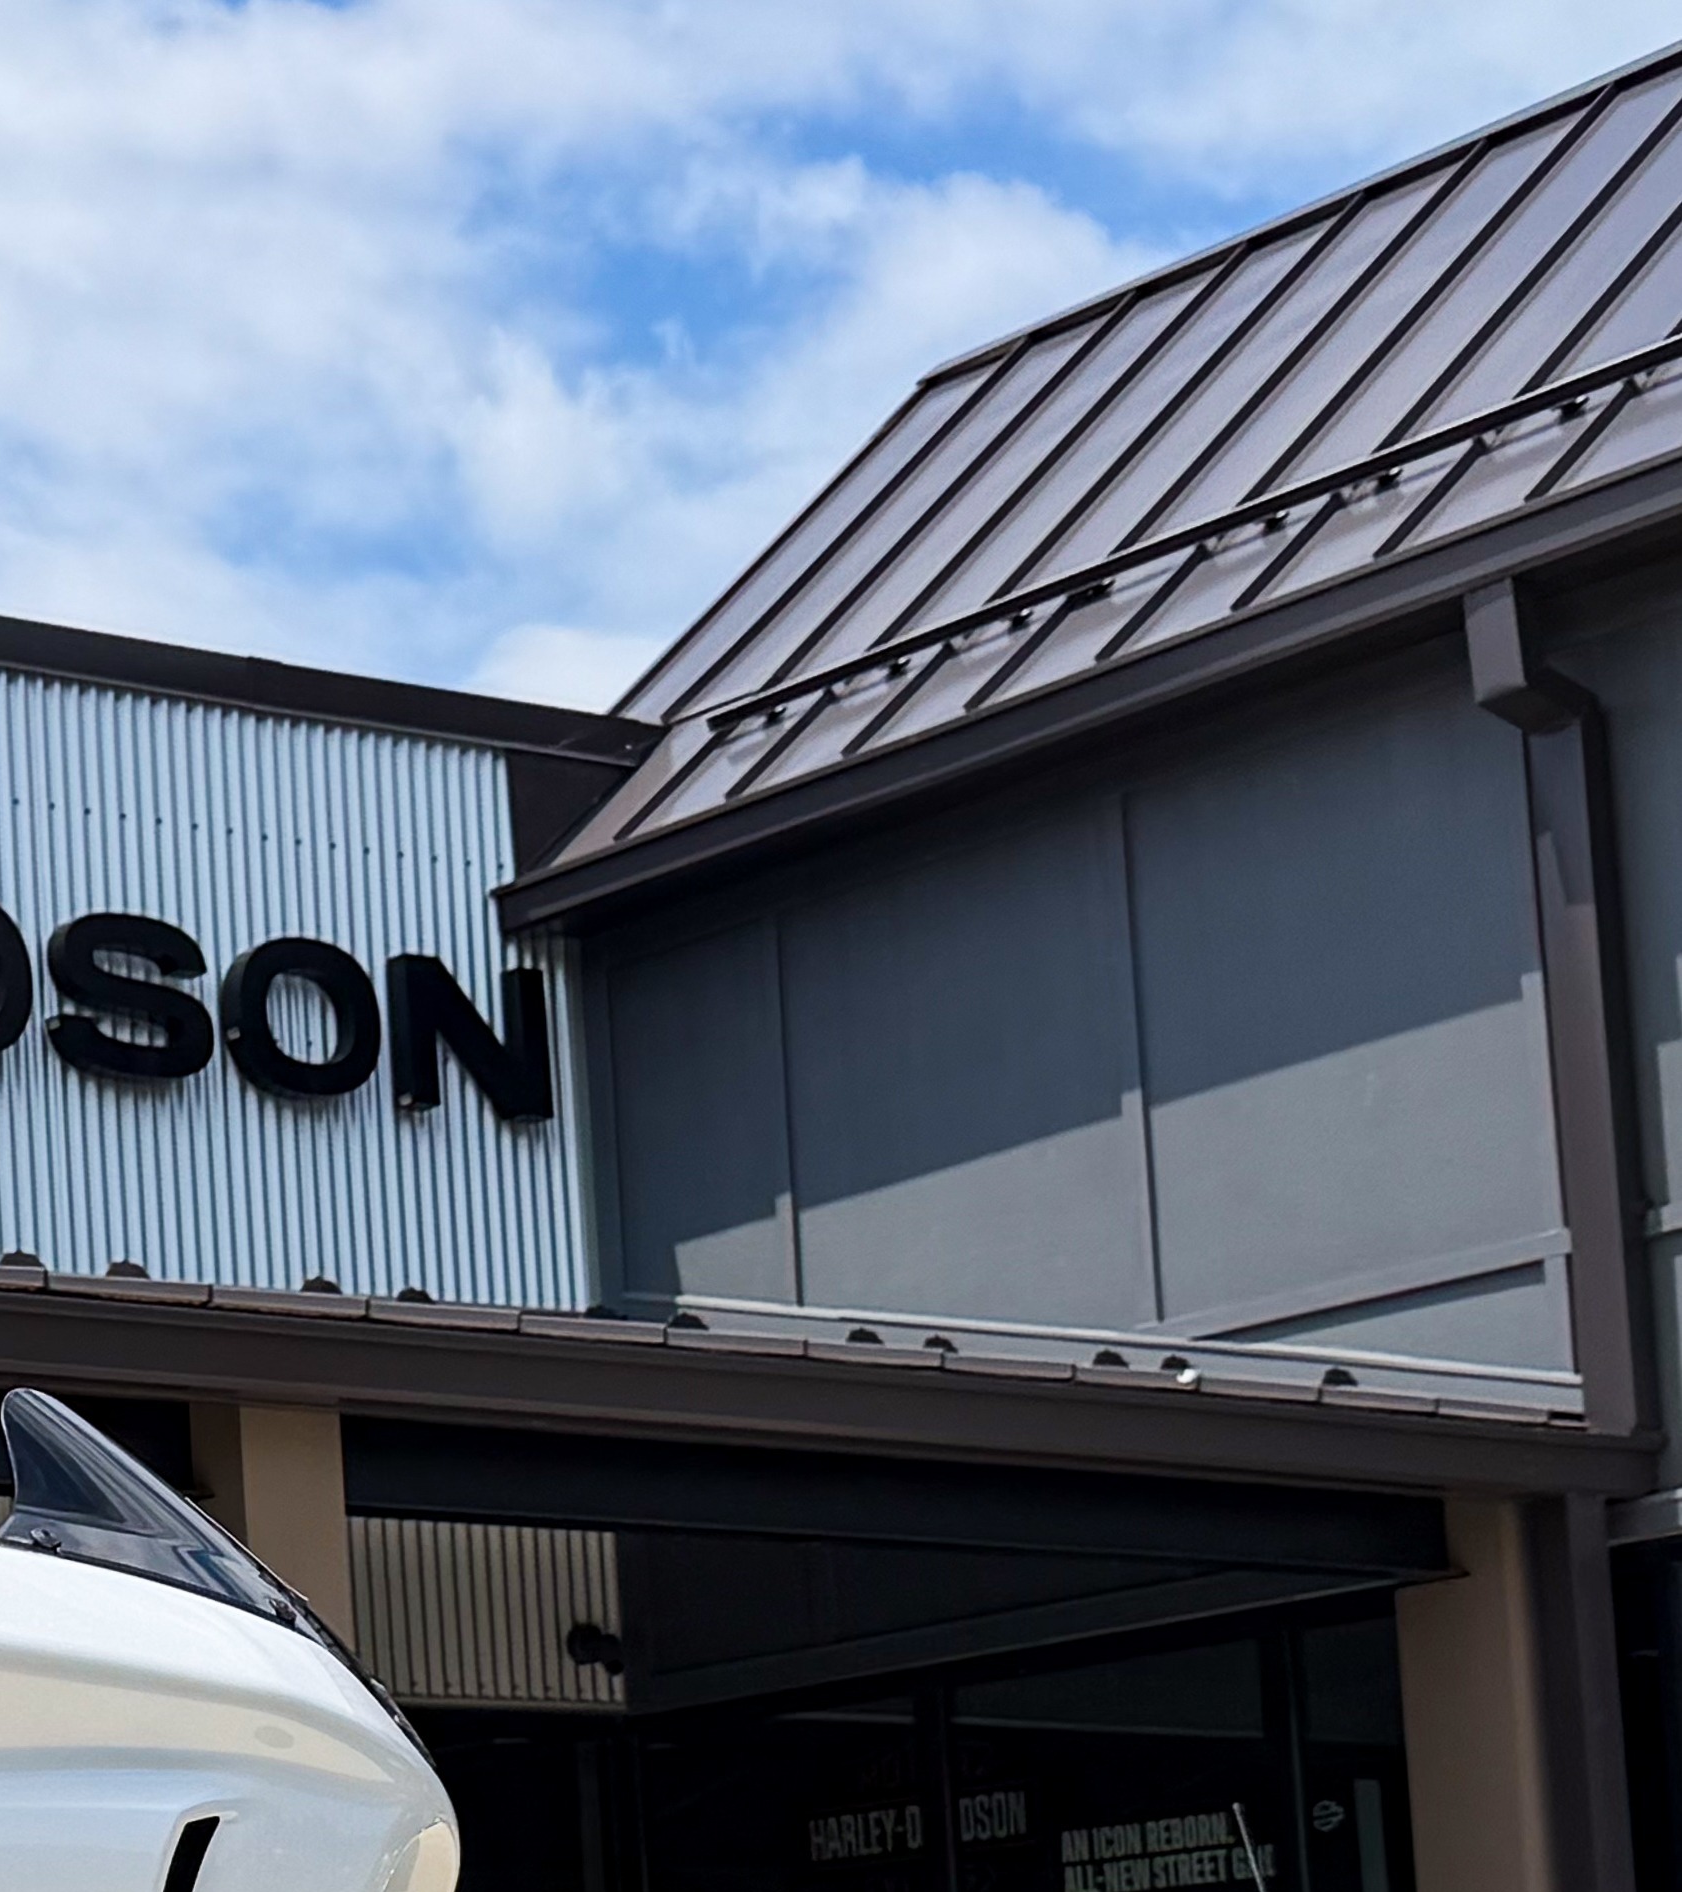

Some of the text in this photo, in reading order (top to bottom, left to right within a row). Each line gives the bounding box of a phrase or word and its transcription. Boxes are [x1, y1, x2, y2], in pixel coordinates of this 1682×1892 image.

[1061, 1828, 1089, 1863] AN
[1092, 1823, 1142, 1860] ICON
[1152, 1848, 1229, 1890] STREET
